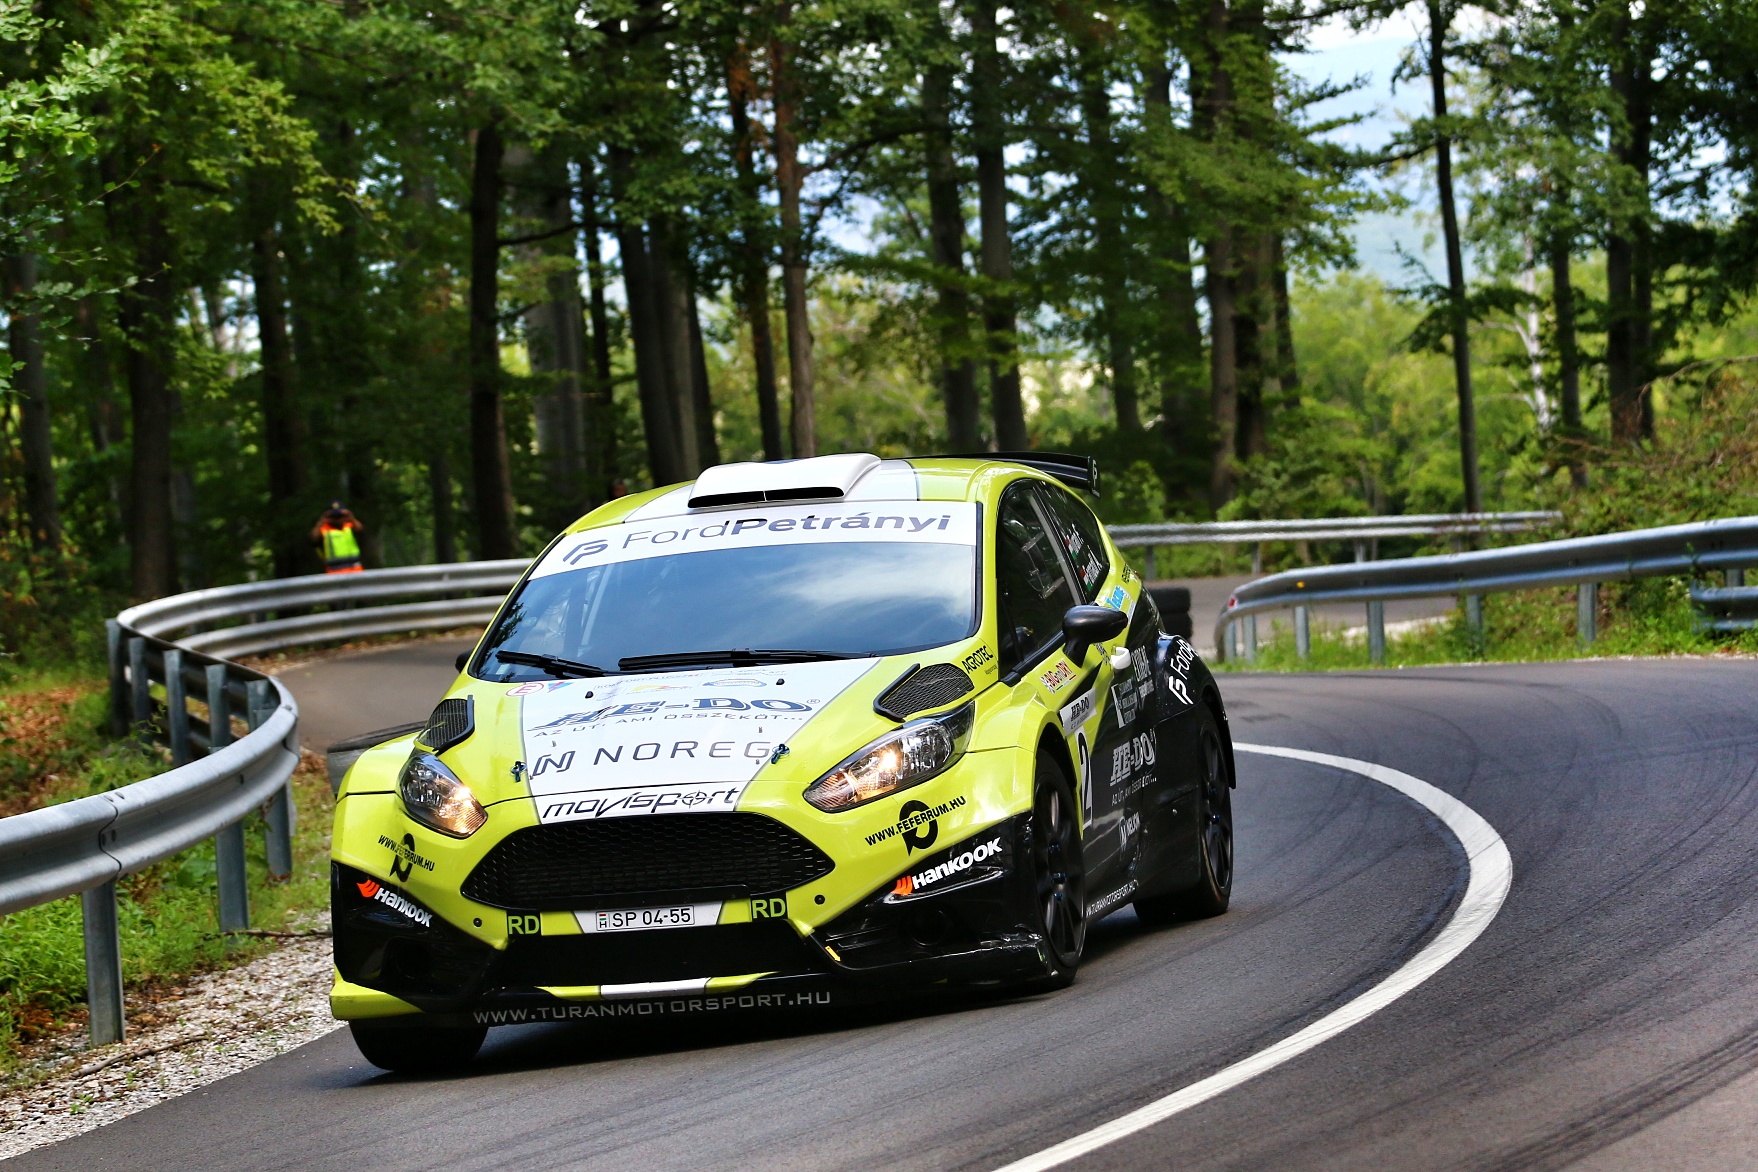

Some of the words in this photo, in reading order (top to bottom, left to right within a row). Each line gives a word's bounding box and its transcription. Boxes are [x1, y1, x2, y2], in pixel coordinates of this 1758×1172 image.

[622, 511, 951, 549] FordPetrányi
[961, 645, 994, 674] AGROTEC
[533, 729, 562, 738] AZ
[615, 716, 653, 724] AMI
[593, 740, 771, 765] NOREG
[1077, 732, 1092, 826] 2
[865, 795, 967, 846] WWW.FEFERRUM.HU
[378, 834, 435, 872] WWW.FEFERRUM.HU
[612, 912, 637, 928] SP
[642, 908, 691, 925] 04-55
[752, 898, 786, 919] RD
[508, 915, 540, 935] RD
[473, 991, 831, 1024] WWW.TURANMOTORSPORT.HU
